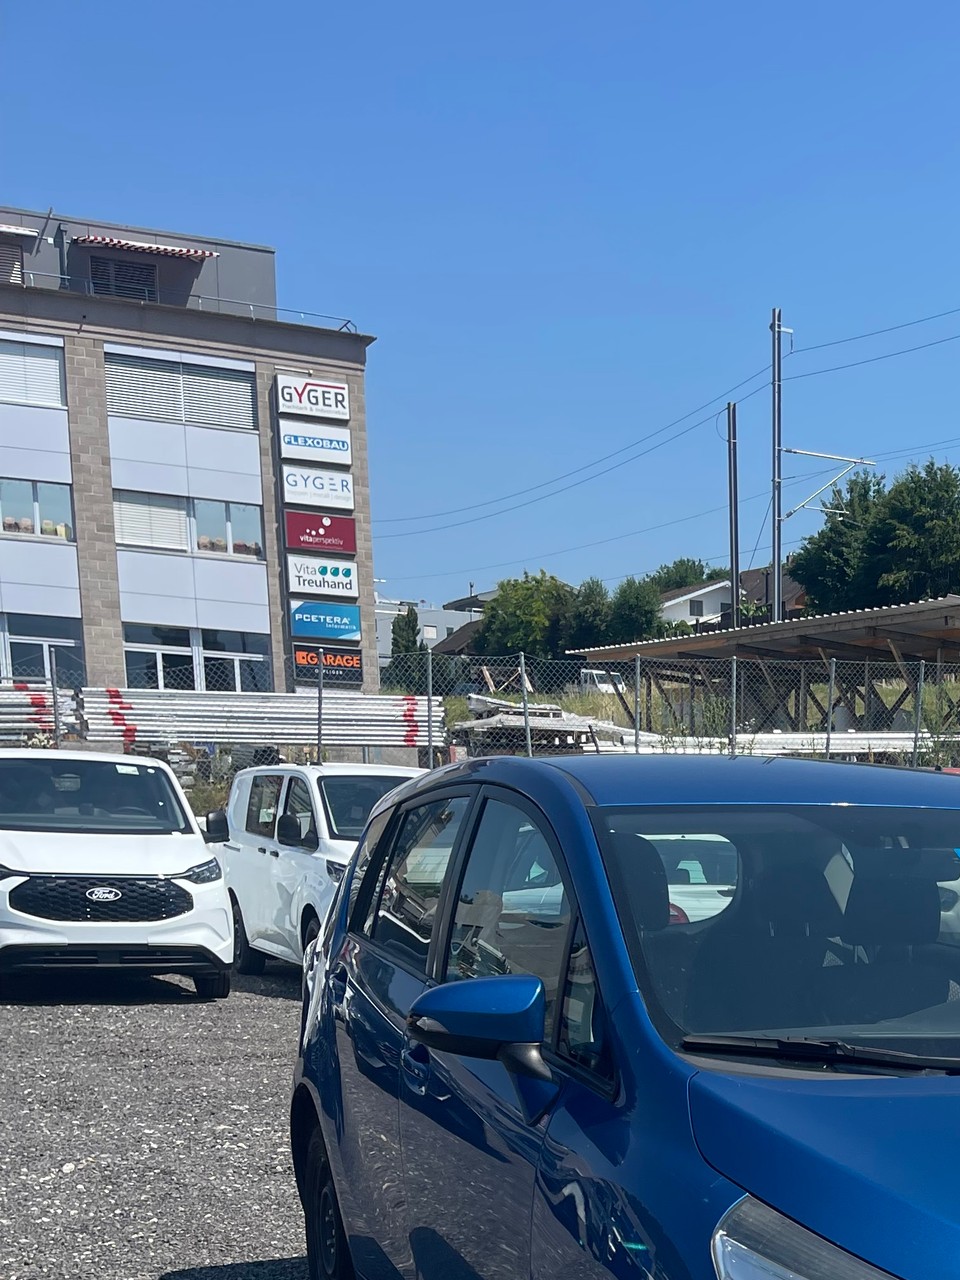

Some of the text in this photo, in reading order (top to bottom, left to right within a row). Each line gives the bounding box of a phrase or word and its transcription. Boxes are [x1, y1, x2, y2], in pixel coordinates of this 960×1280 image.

[281, 383, 346, 409] GYGER
[284, 436, 348, 450] FLEXOBAU
[286, 473, 351, 493] GYGER
[294, 562, 317, 576] Vita
[295, 575, 353, 590] Treuhand
[91, 888, 117, 899] Ford
